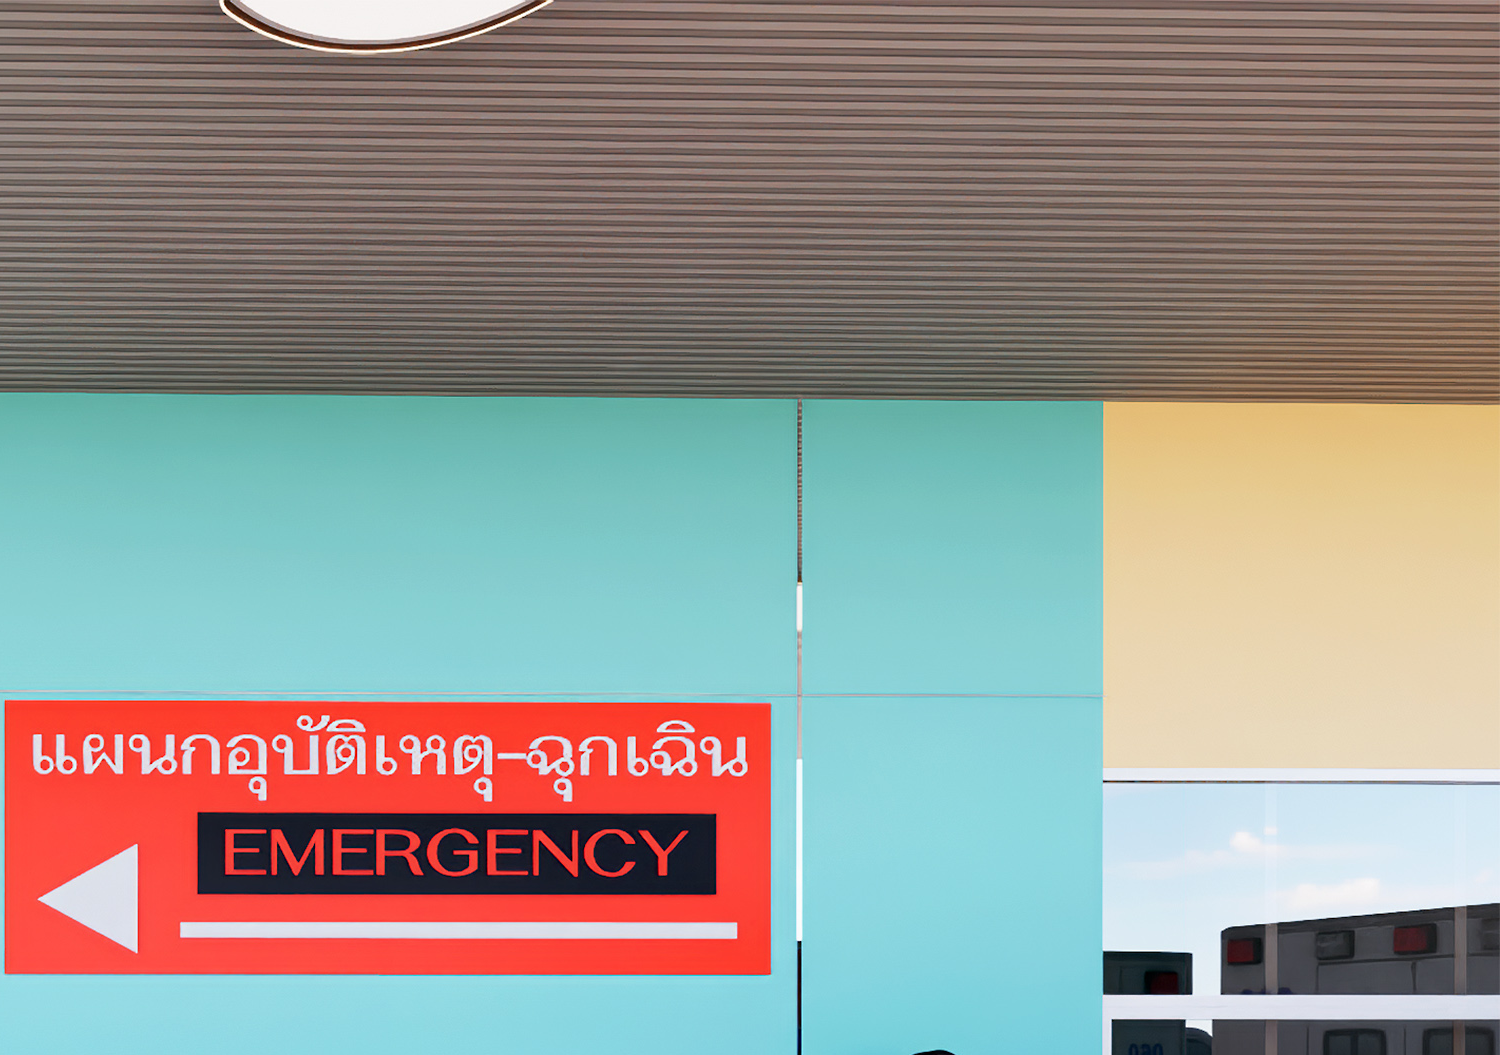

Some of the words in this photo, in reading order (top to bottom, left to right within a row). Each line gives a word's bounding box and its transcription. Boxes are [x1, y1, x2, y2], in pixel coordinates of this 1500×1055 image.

[31, 714, 749, 802] แผนกอุบัติเหตุ-ฉุกเฉิน
[224, 828, 689, 878] EMERGENCY
